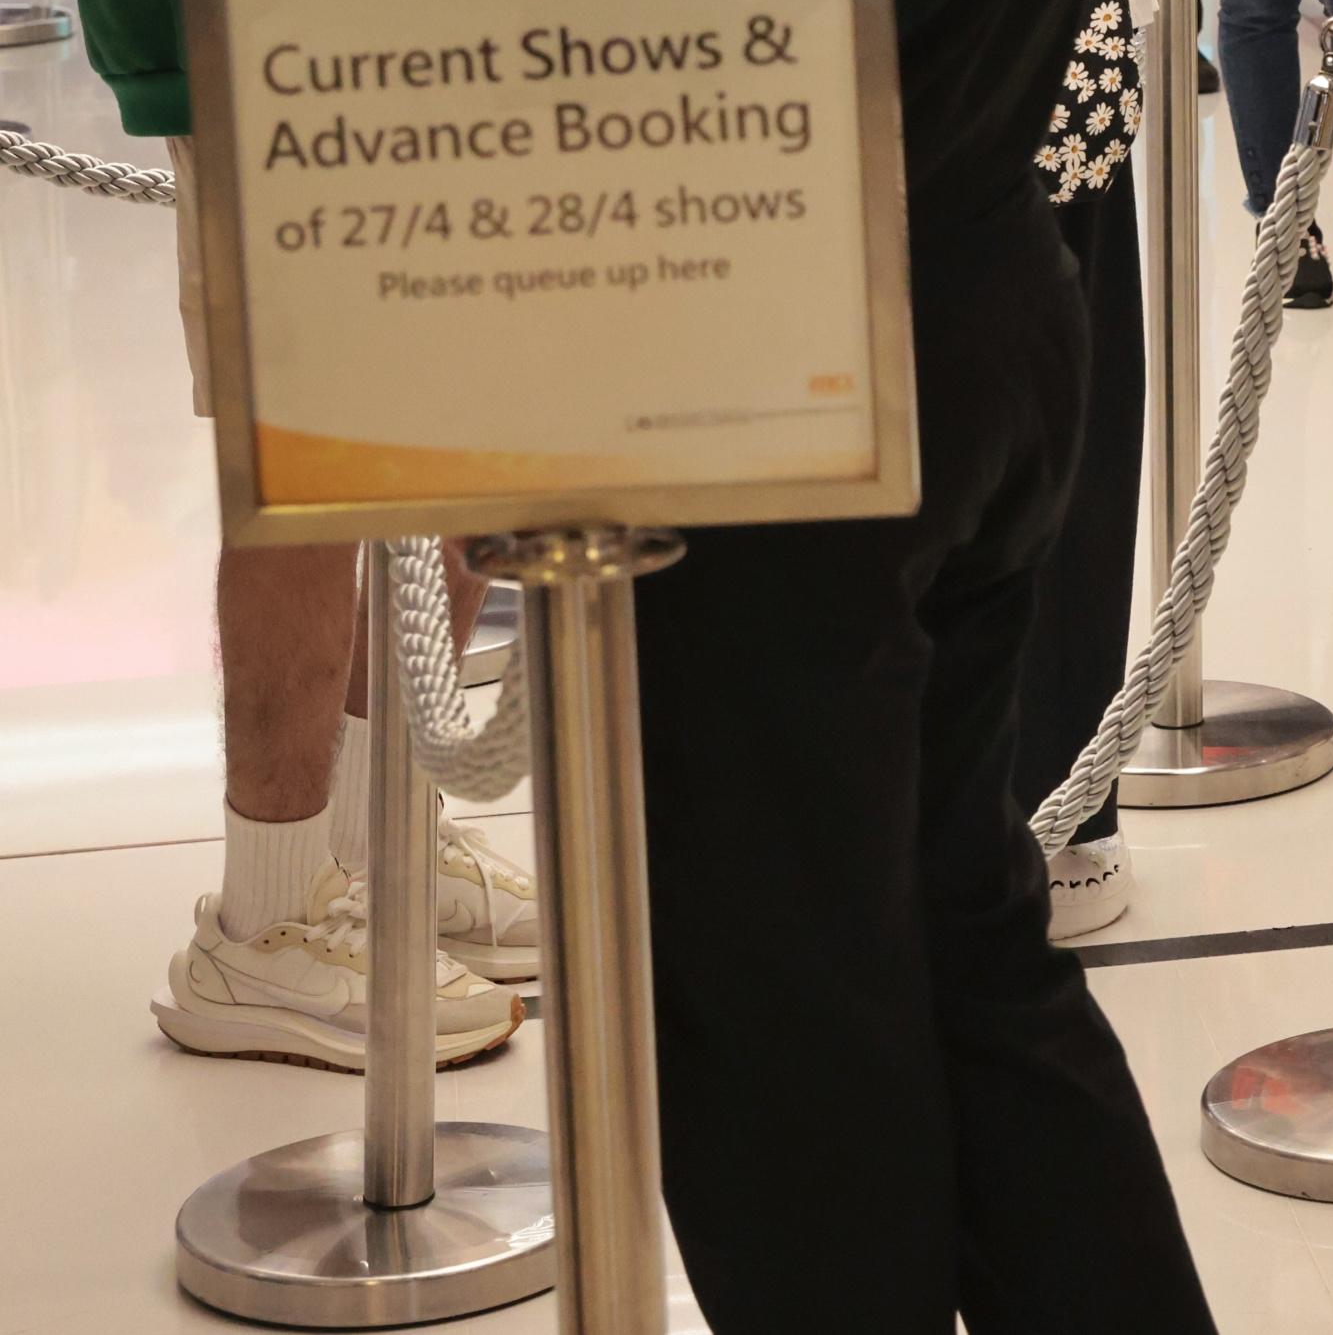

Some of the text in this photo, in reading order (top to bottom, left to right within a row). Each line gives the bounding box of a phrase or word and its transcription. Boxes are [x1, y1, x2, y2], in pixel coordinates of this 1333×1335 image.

[263, 14, 797, 96] Current Shows &
[266, 91, 812, 169] Advance Booking
[275, 183, 806, 252] of 27/4 & 28/4 shows
[378, 254, 730, 300] Please queue up here
